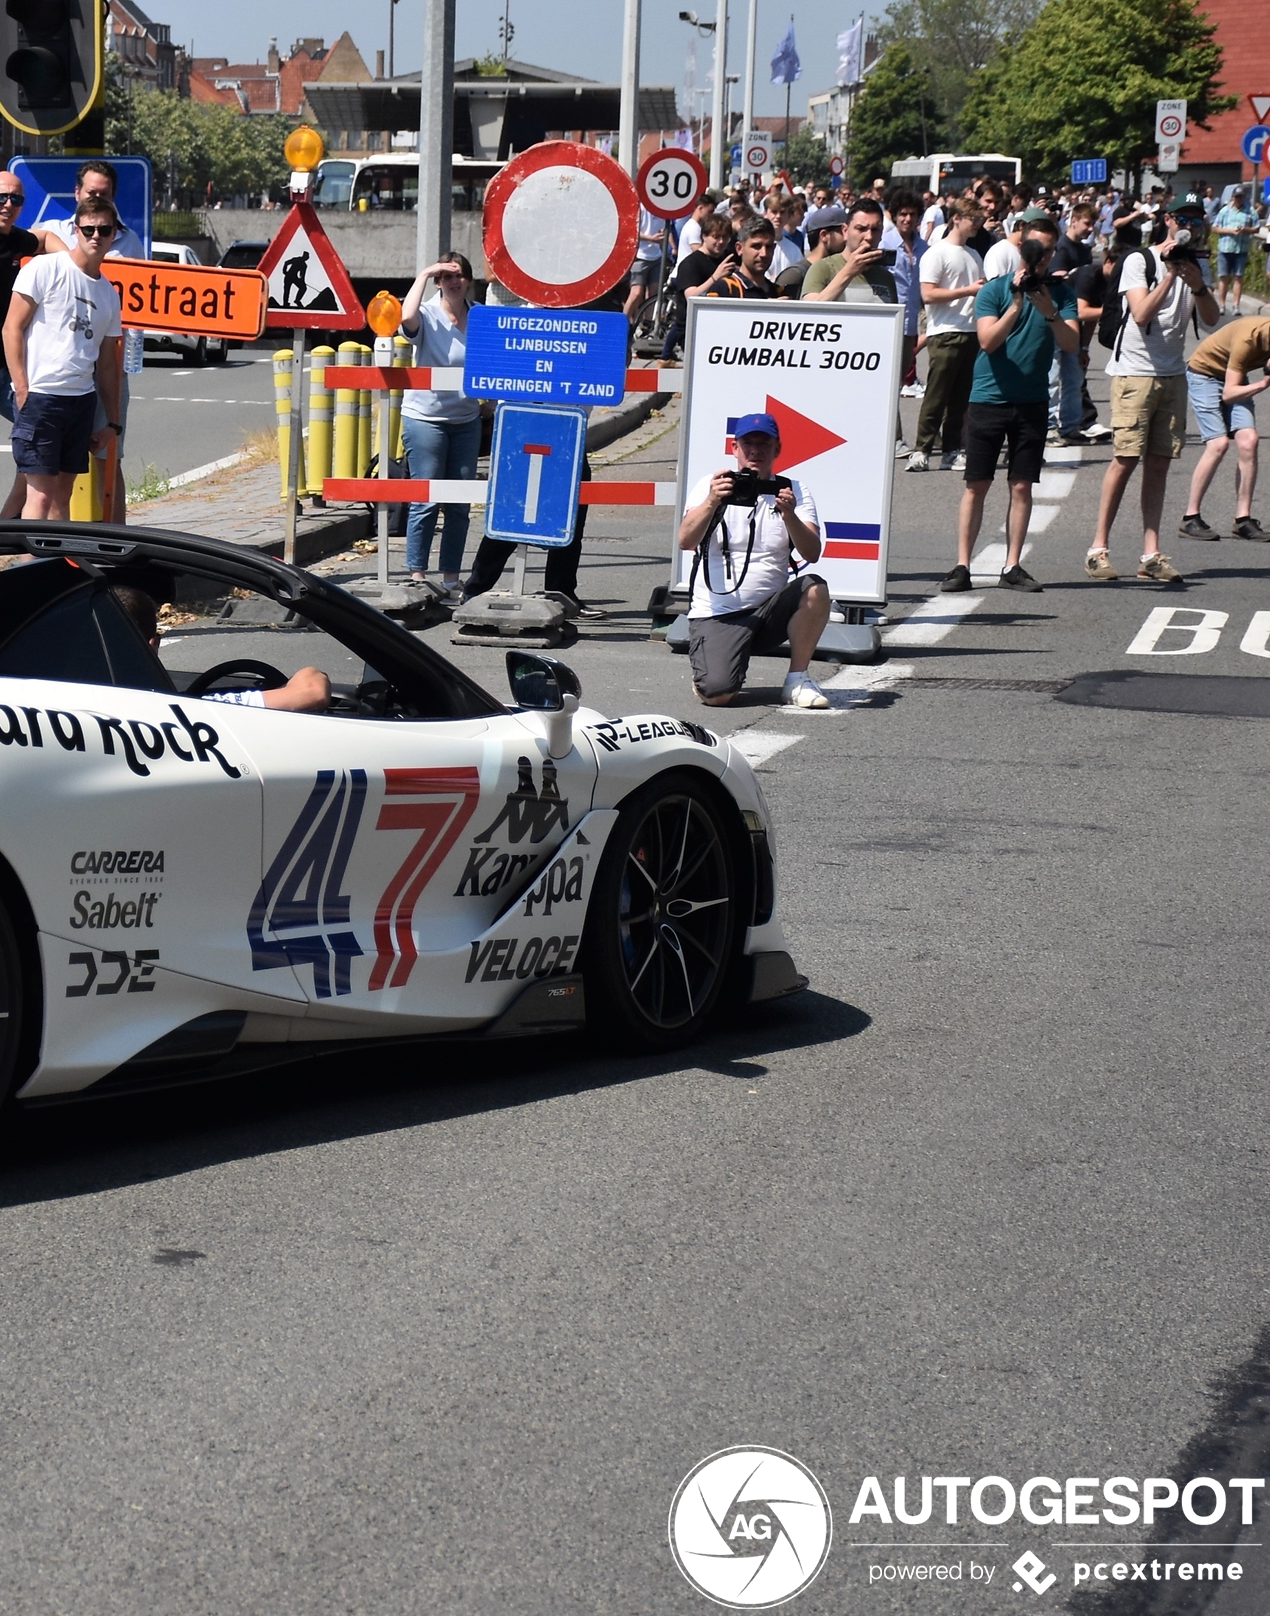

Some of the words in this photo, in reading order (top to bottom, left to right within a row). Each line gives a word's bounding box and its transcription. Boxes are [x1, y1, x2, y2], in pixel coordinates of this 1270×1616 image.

[1161, 102, 1182, 110] ZONE
[1164, 121, 1178, 131] 30
[749, 133, 768, 141] ZONE
[752, 152, 764, 161] 30
[651, 169, 692, 199] 30
[497, 316, 598, 335] UITGEZONDERD
[749, 321, 843, 342] DRIVERS
[505, 338, 587, 355] LIJNBUSSEN
[535, 359, 553, 373] EN
[708, 346, 811, 368] GUMBALL
[819, 350, 881, 371] 3000
[471, 376, 552, 393] LEVERINGEN
[560, 381, 572, 394] 'T
[578, 383, 615, 397] ZAND
[71, 850, 165, 875] CARRERA
[69, 877, 109, 885] EYEWEAR
[114, 876, 139, 884] SINCE
[247, 766, 480, 999] 47
[69, 890, 159, 929] Sabelt
[464, 935, 579, 984] VELOCE
